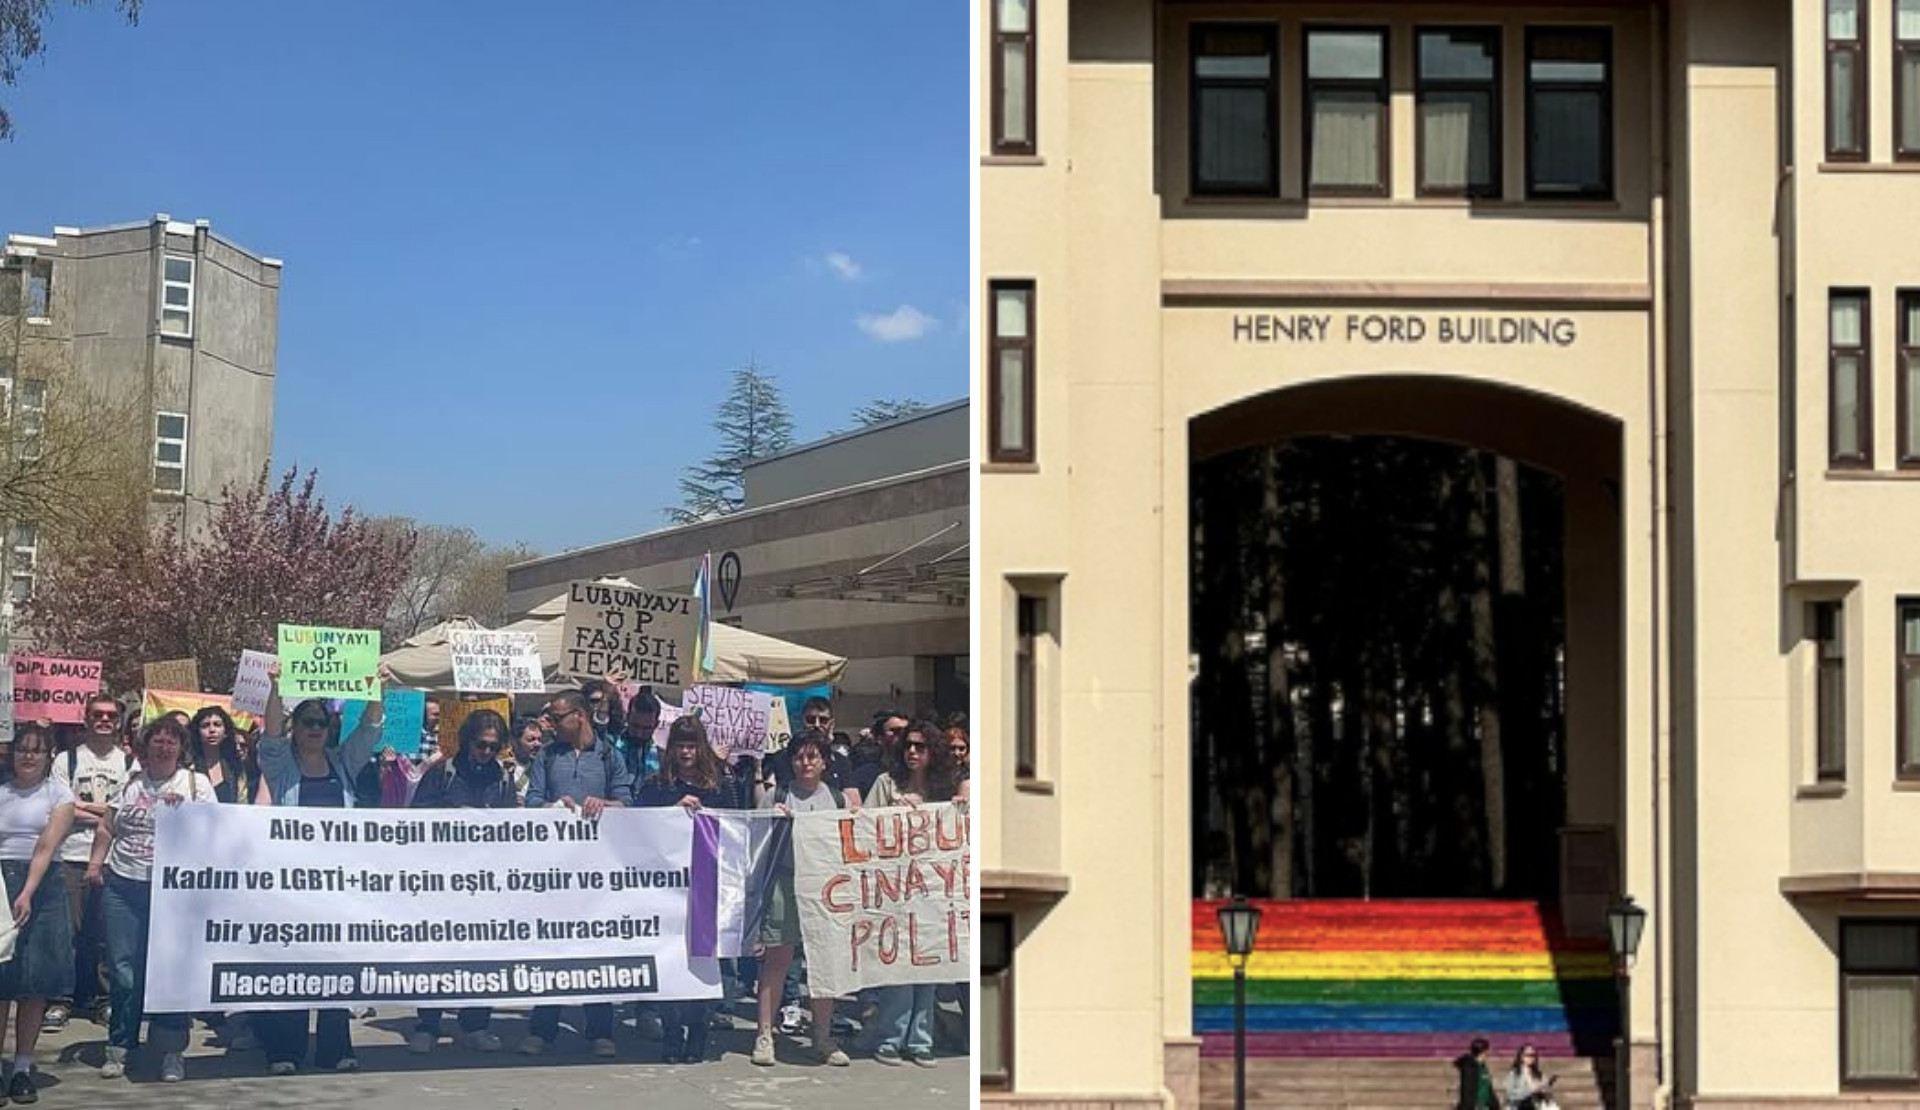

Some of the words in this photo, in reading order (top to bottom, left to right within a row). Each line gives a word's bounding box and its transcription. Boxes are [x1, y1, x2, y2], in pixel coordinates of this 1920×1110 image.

[1234, 314, 1331, 342] HENRY
[1346, 316, 1426, 342] FORD
[1438, 317, 1576, 346] BUILDING
[571, 583, 690, 615] LUBUNYAYI
[283, 629, 370, 645] LUBUNYAYI
[567, 648, 680, 685] TEKMELE
[270, 819, 315, 841] Aile
[321, 820, 358, 842] Yılı
[364, 820, 425, 845] Değil
[432, 820, 548, 843] Mücadele
[554, 819, 599, 841] Yılı!
[839, 810, 970, 864] LUBU
[162, 866, 239, 890] Kadın
[245, 871, 274, 890] ve
[280, 866, 393, 891] LGBTİ+lar
[399, 870, 445, 896] için
[450, 870, 502, 896] eşit,
[507, 868, 572, 893] özgür
[577, 872, 604, 889] ve
[206, 919, 243, 942] bir
[249, 923, 341, 947] yaşamı
[347, 919, 531, 942] mücadelemizle
[536, 914, 660, 941] kuracağız!
[219, 971, 355, 997] Hacettepe
[360, 966, 508, 995] Üniversitesi
[513, 963, 650, 994] Öğrencileri
